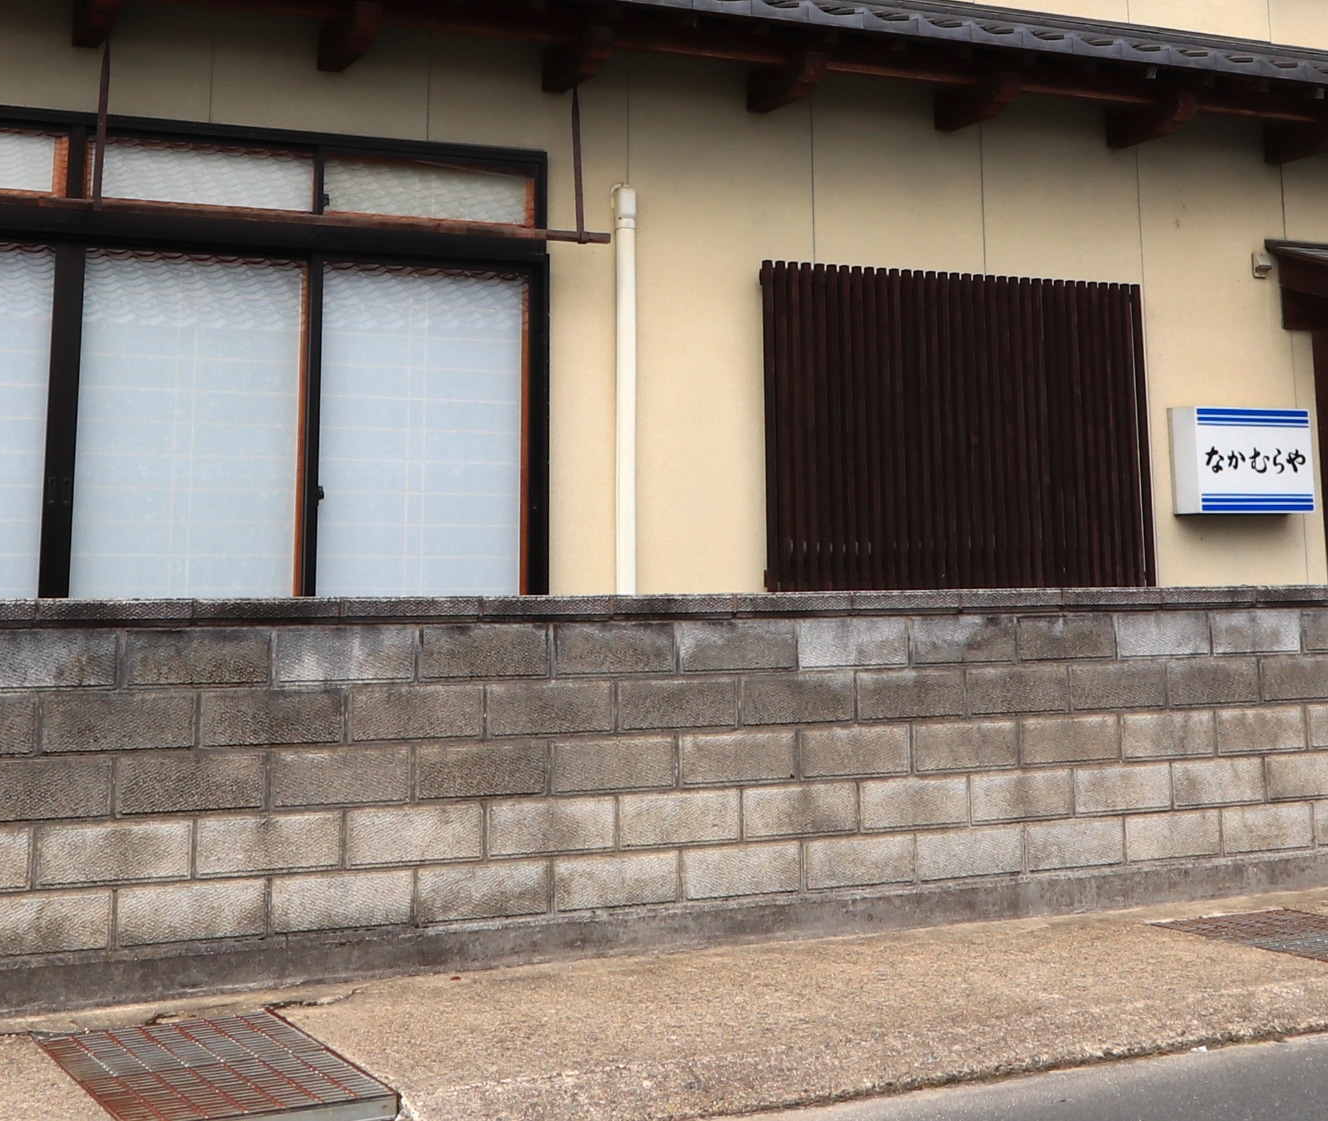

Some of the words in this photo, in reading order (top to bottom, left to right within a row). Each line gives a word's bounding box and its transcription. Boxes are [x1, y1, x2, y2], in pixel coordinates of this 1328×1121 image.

[1205, 446, 1306, 474] なかむらや
